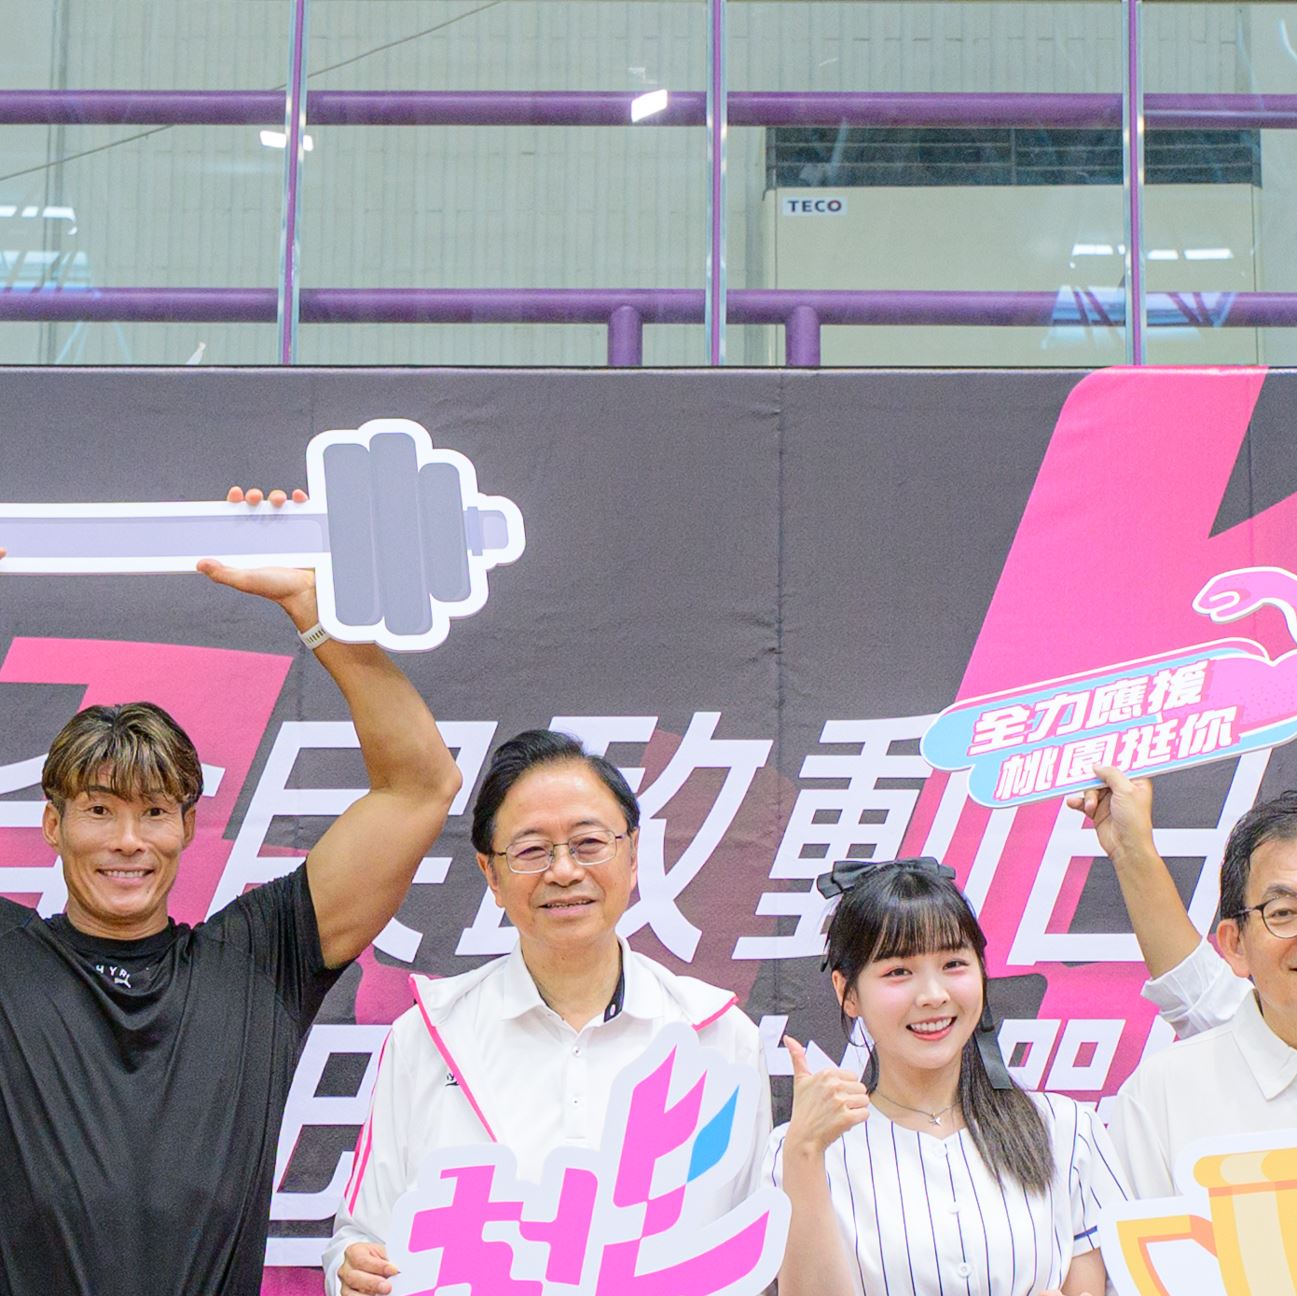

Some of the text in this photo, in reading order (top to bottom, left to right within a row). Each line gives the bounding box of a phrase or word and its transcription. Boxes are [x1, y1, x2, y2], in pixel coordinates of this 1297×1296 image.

[787, 199, 842, 213] TECO
[967, 660, 1209, 755] 全力應援
[994, 706, 1238, 801] 桃園挺你
